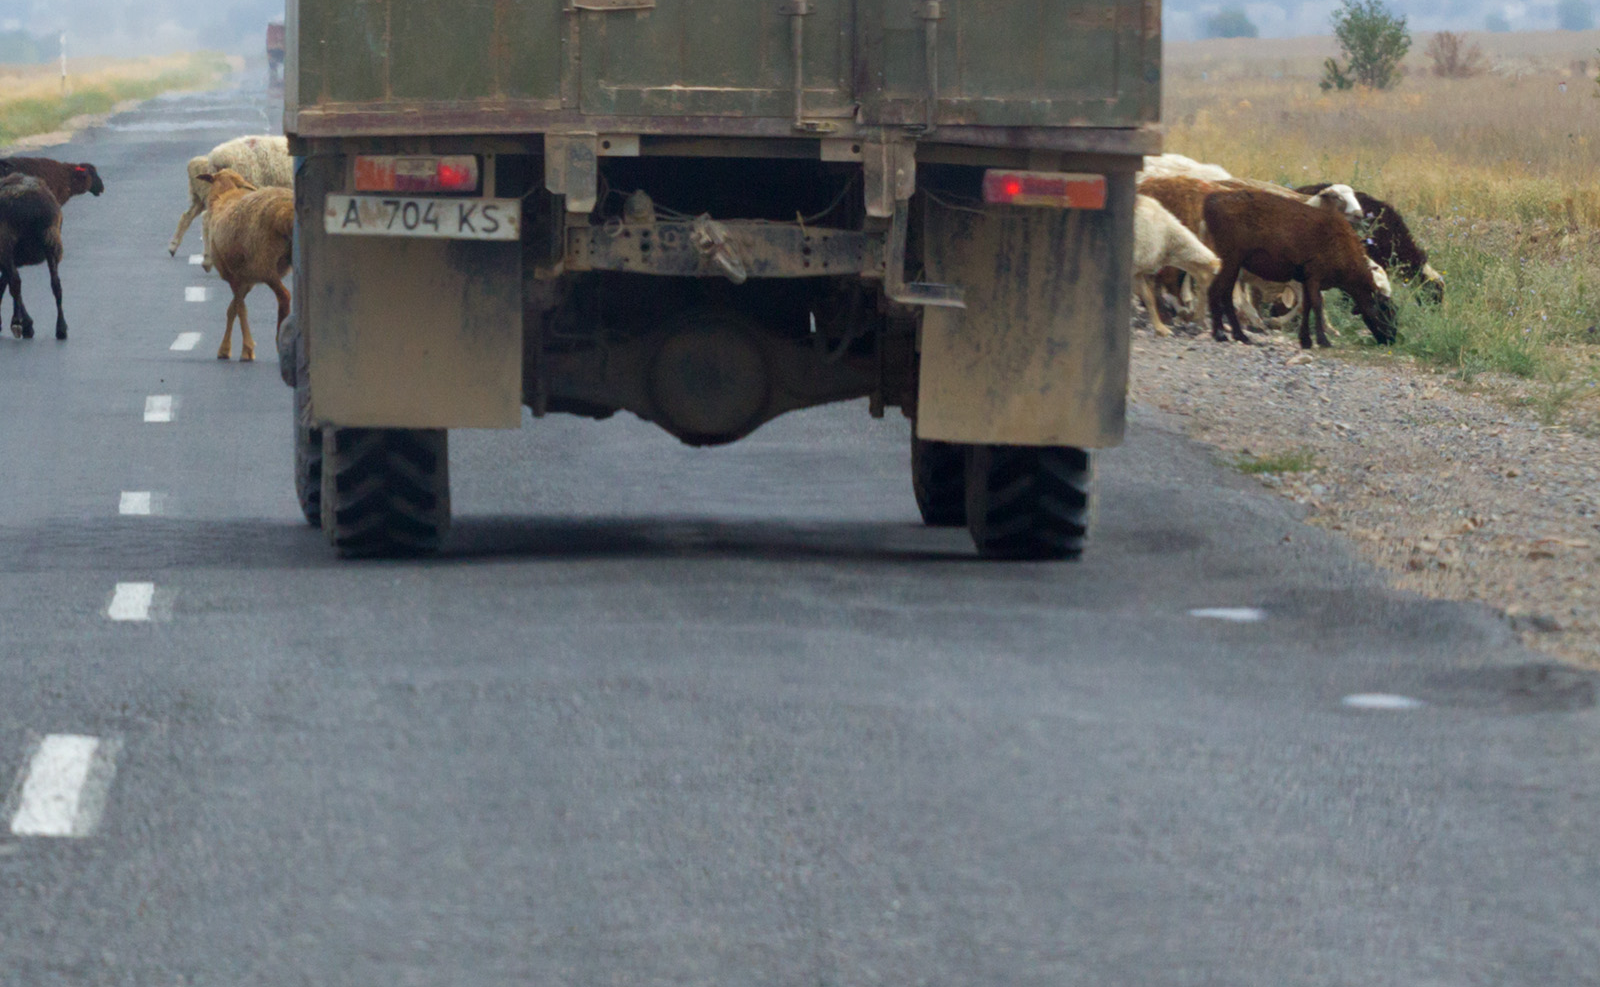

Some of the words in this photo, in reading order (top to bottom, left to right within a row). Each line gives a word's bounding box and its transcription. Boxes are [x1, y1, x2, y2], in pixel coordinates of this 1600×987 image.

[342, 199, 362, 229] A
[382, 200, 439, 232] 704
[458, 203, 500, 234] KS
